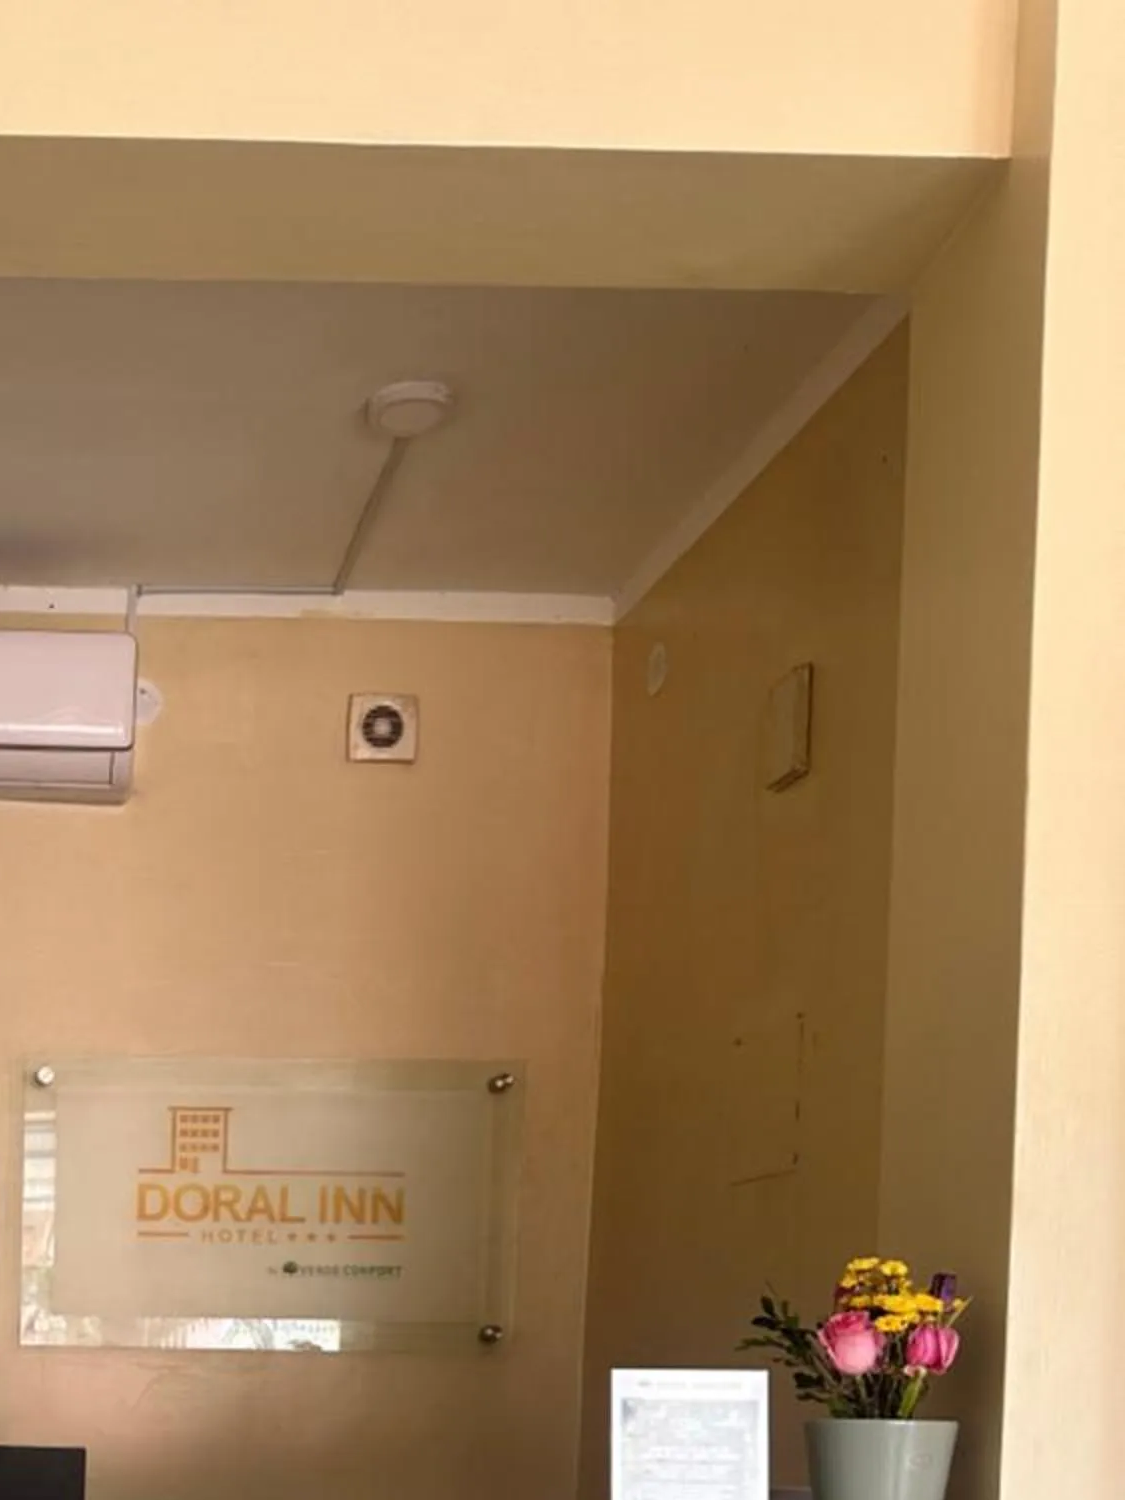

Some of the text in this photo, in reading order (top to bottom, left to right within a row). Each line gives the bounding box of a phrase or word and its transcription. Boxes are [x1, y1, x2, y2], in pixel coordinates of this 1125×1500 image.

[136, 1183, 404, 1225] DORAL INN
[201, 1228, 278, 1244] HOTEL
